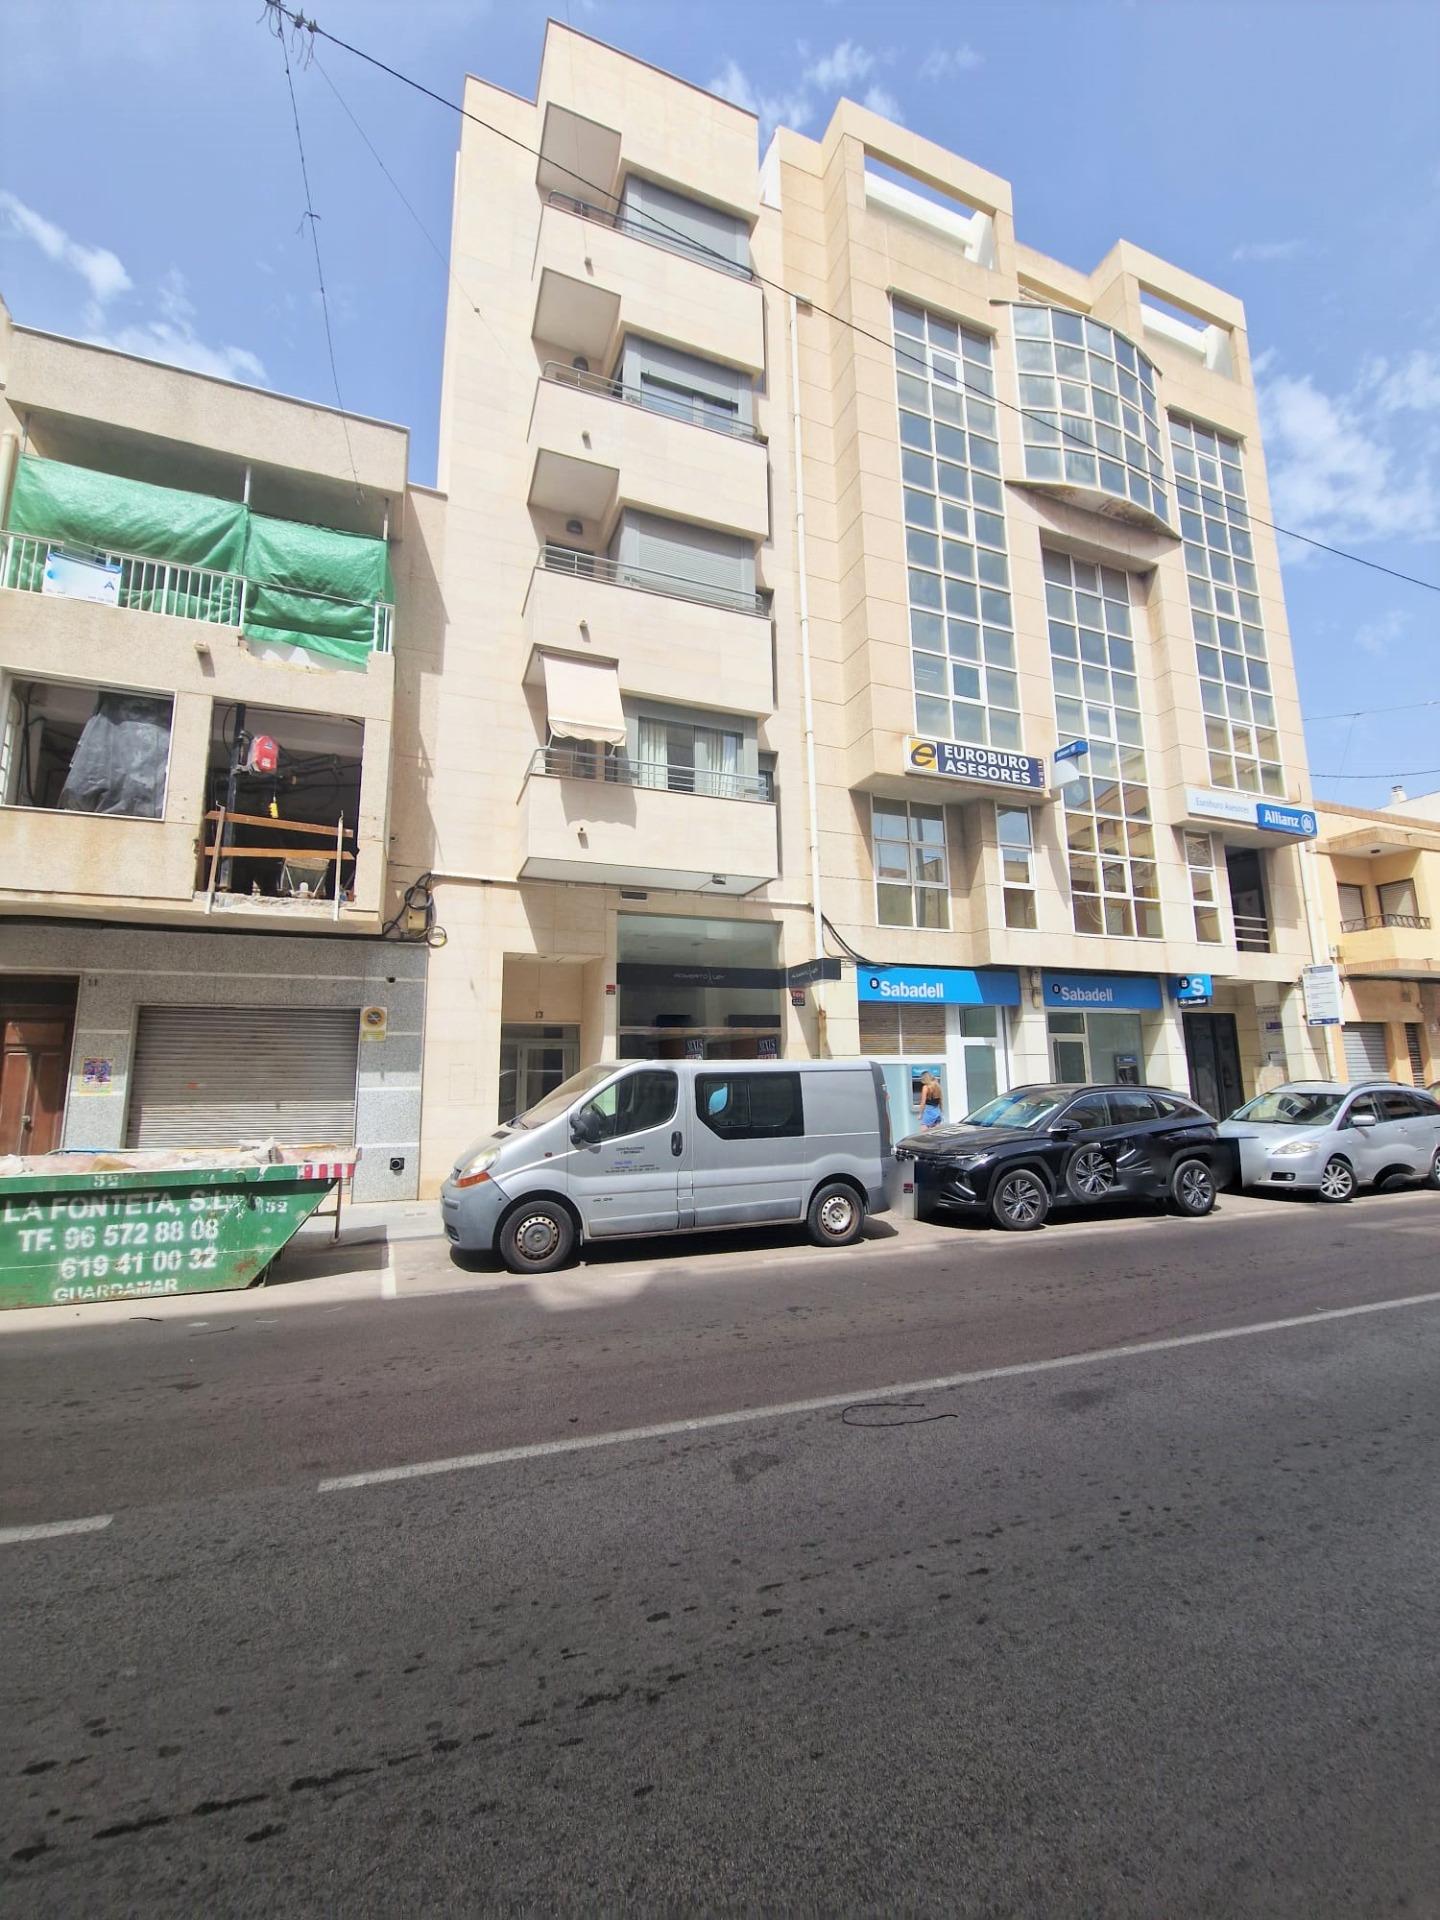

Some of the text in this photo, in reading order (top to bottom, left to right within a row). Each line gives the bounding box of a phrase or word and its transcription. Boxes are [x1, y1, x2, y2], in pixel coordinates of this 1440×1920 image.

[944, 744, 1030, 770] EUROBURO
[944, 762, 1031, 784] ASESORES
[1264, 809, 1300, 827] Allianz
[880, 981, 944, 998] Sabadell
[1061, 986, 1113, 1002] Sabadell
[1191, 978, 1205, 996] S
[93, 1174, 119, 1187] 52
[4, 1200, 43, 1222] LA
[51, 1191, 182, 1220] FONTETA,
[18, 1216, 219, 1252] TF. 96 572 88 08
[60, 1246, 217, 1280] 619 41 00 32
[53, 1278, 178, 1301] GUARDAMAR
